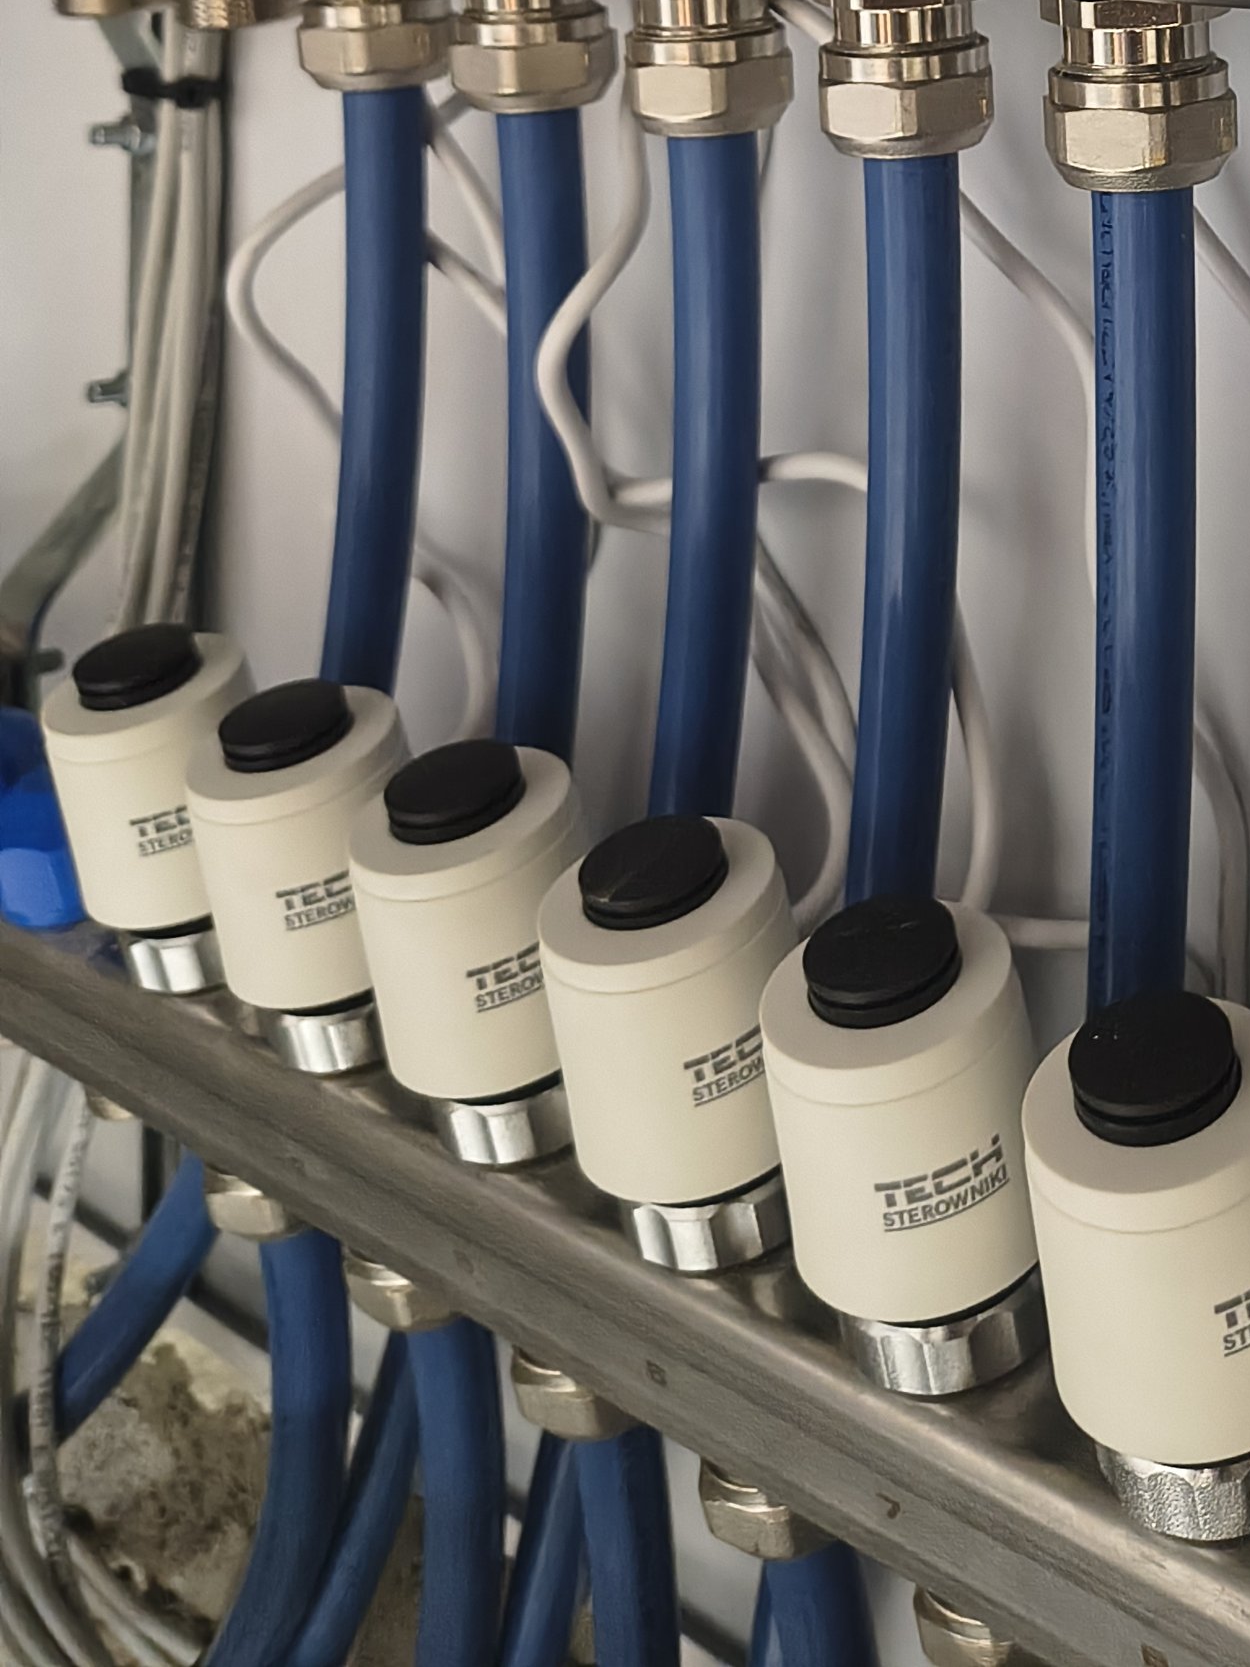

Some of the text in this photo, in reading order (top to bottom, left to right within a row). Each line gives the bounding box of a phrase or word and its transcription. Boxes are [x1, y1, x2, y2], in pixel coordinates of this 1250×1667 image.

[130, 804, 191, 837] TEC
[276, 869, 353, 911] TEC
[466, 941, 542, 990] TEC
[683, 1023, 763, 1083] TEC
[874, 1133, 1004, 1208] TECH
[883, 1163, 1008, 1228] STEROWNIKI
